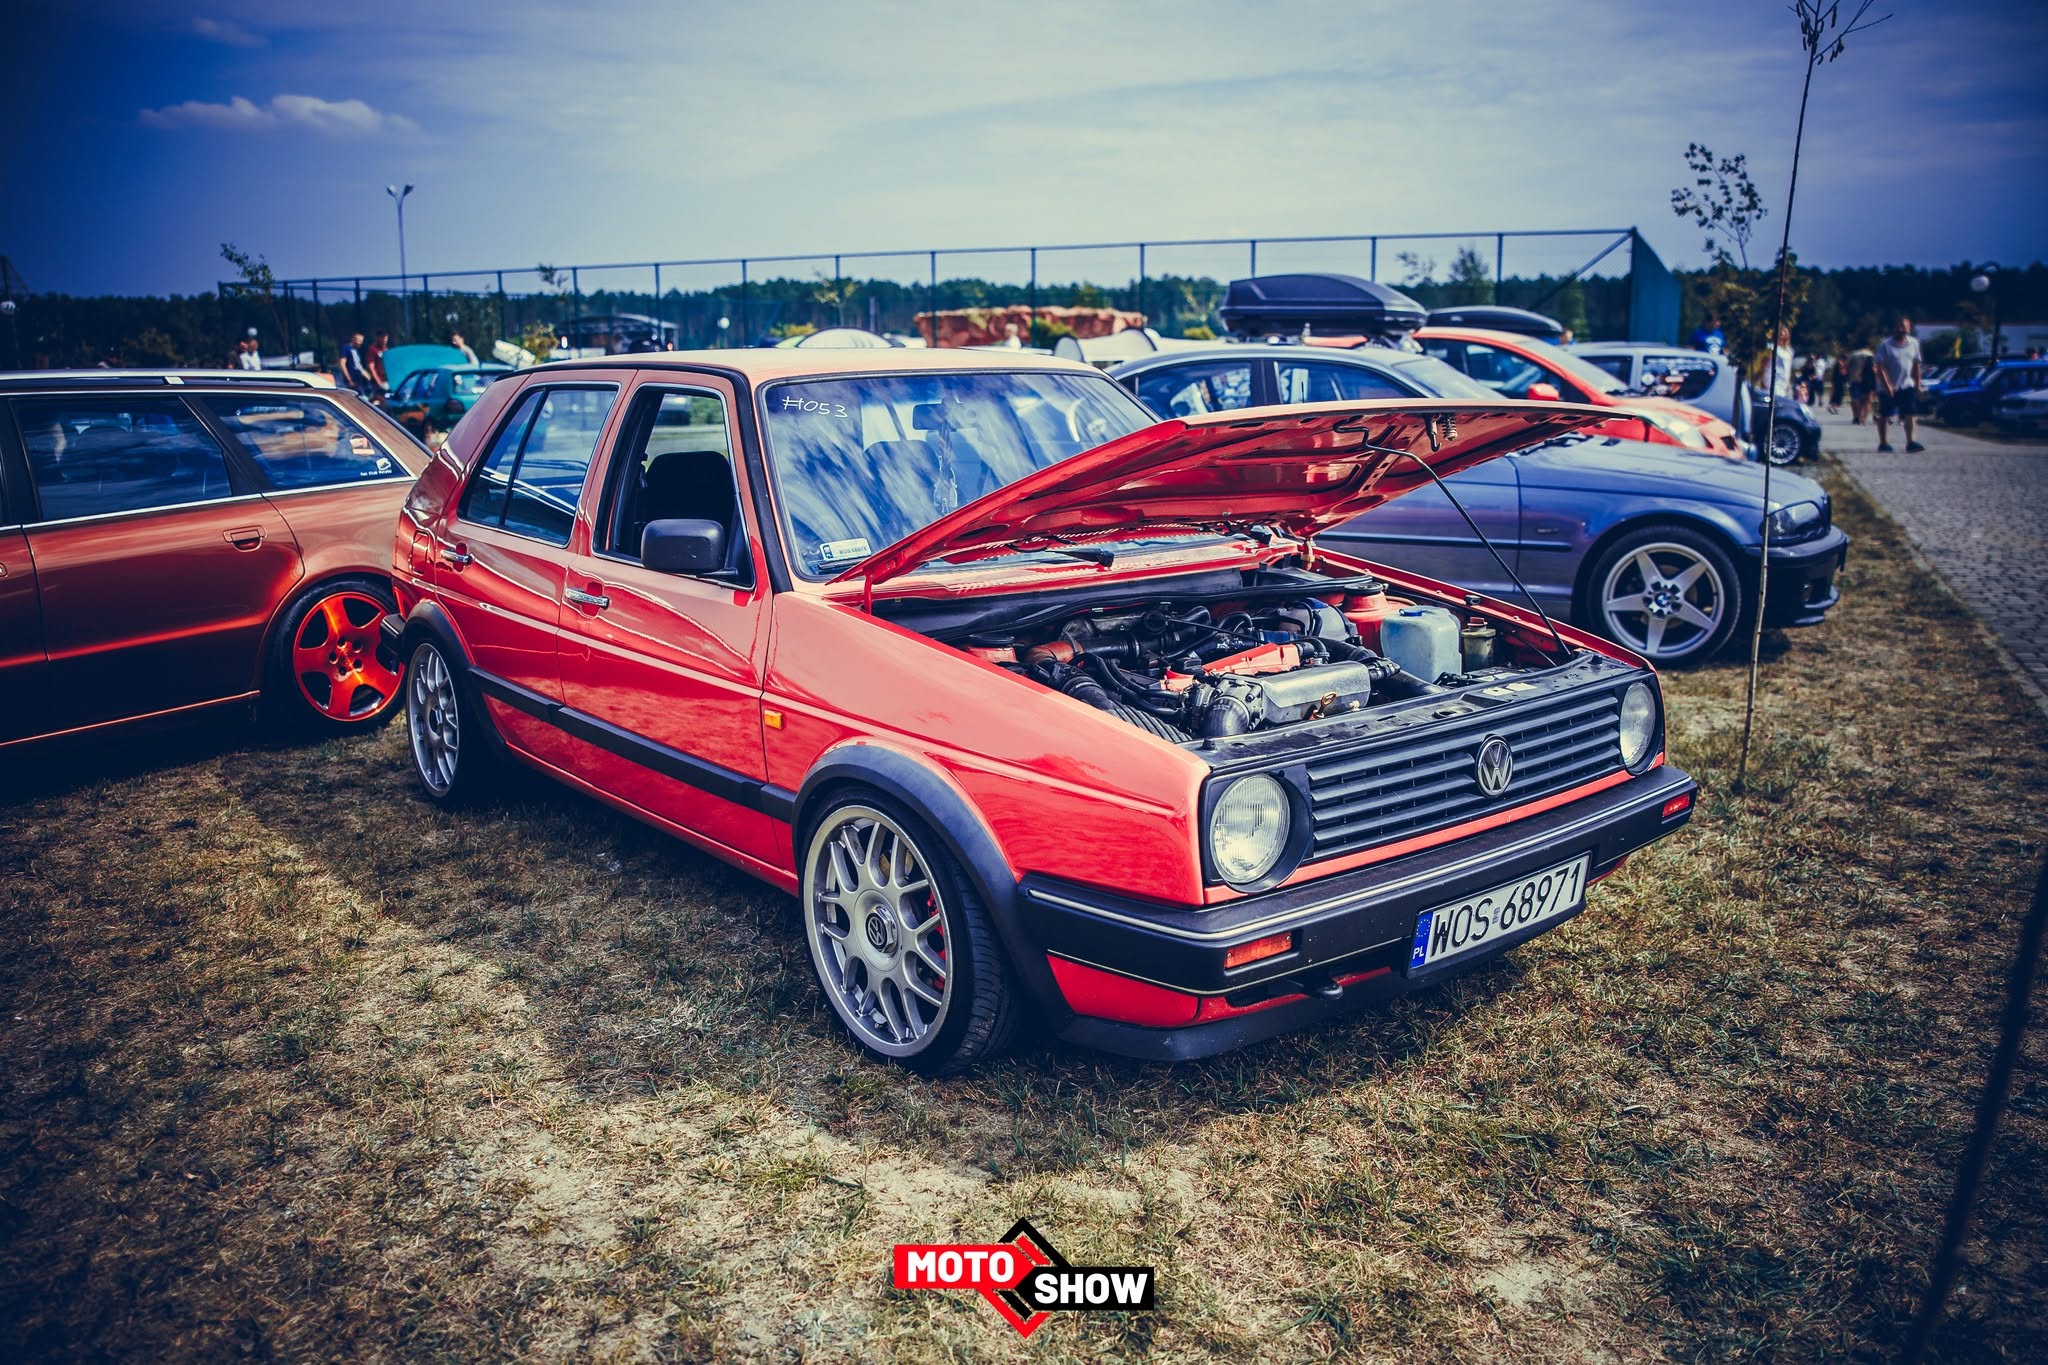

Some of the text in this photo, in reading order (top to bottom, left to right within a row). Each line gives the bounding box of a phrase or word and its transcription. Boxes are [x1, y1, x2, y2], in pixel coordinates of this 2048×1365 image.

[1430, 861, 1581, 957] WOS 68971
[1412, 945, 1425, 960] PL
